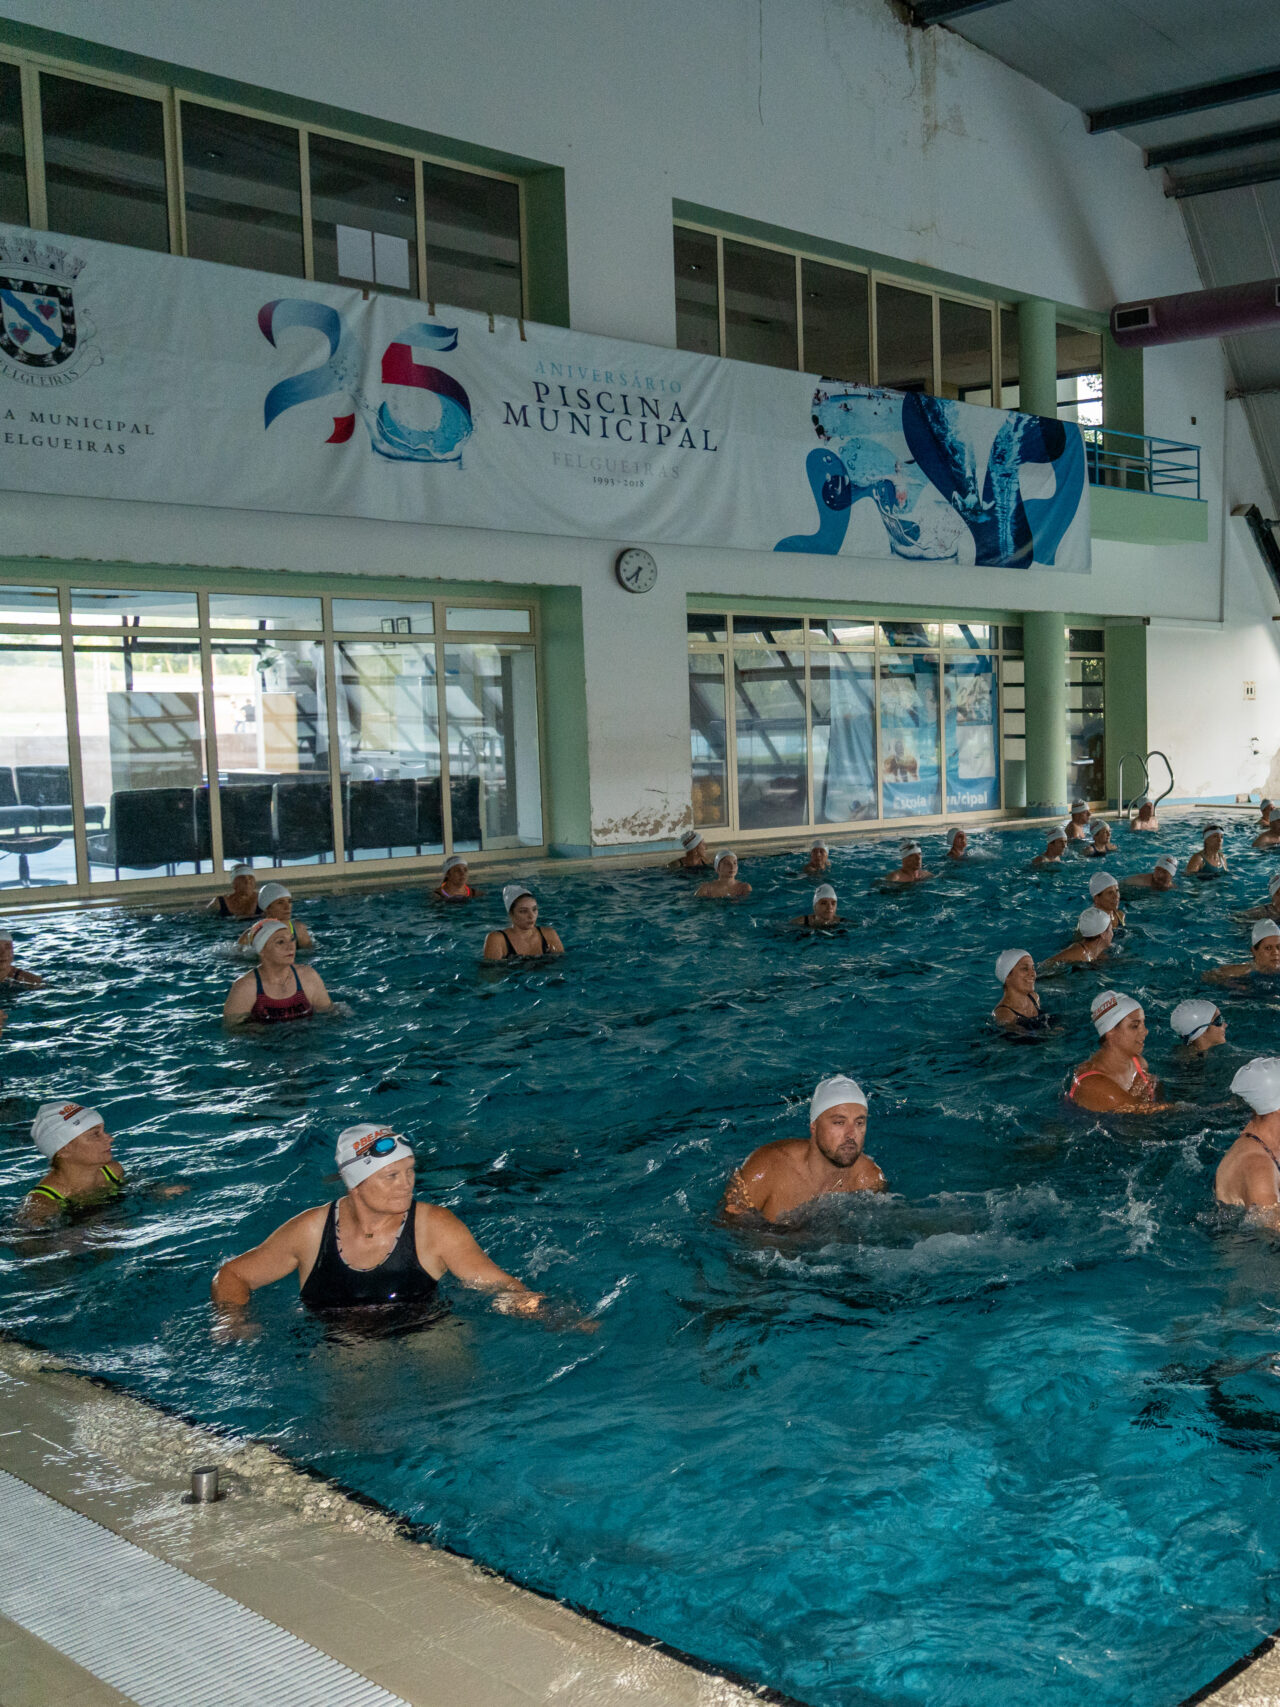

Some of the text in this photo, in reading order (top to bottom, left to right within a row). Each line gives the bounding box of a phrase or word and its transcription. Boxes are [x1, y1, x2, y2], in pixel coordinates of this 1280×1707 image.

[534, 359, 683, 394] ANIVERSÁRIO
[532, 381, 688, 423] PISCINA
[29, 411, 156, 436] MUNICIPAL
[502, 401, 719, 452] MUNICIPAL
[3, 432, 127, 455] ELGUEIRAS
[552, 451, 681, 480] FELGUEIRAS
[929, 791, 988, 808] Mnicipal
